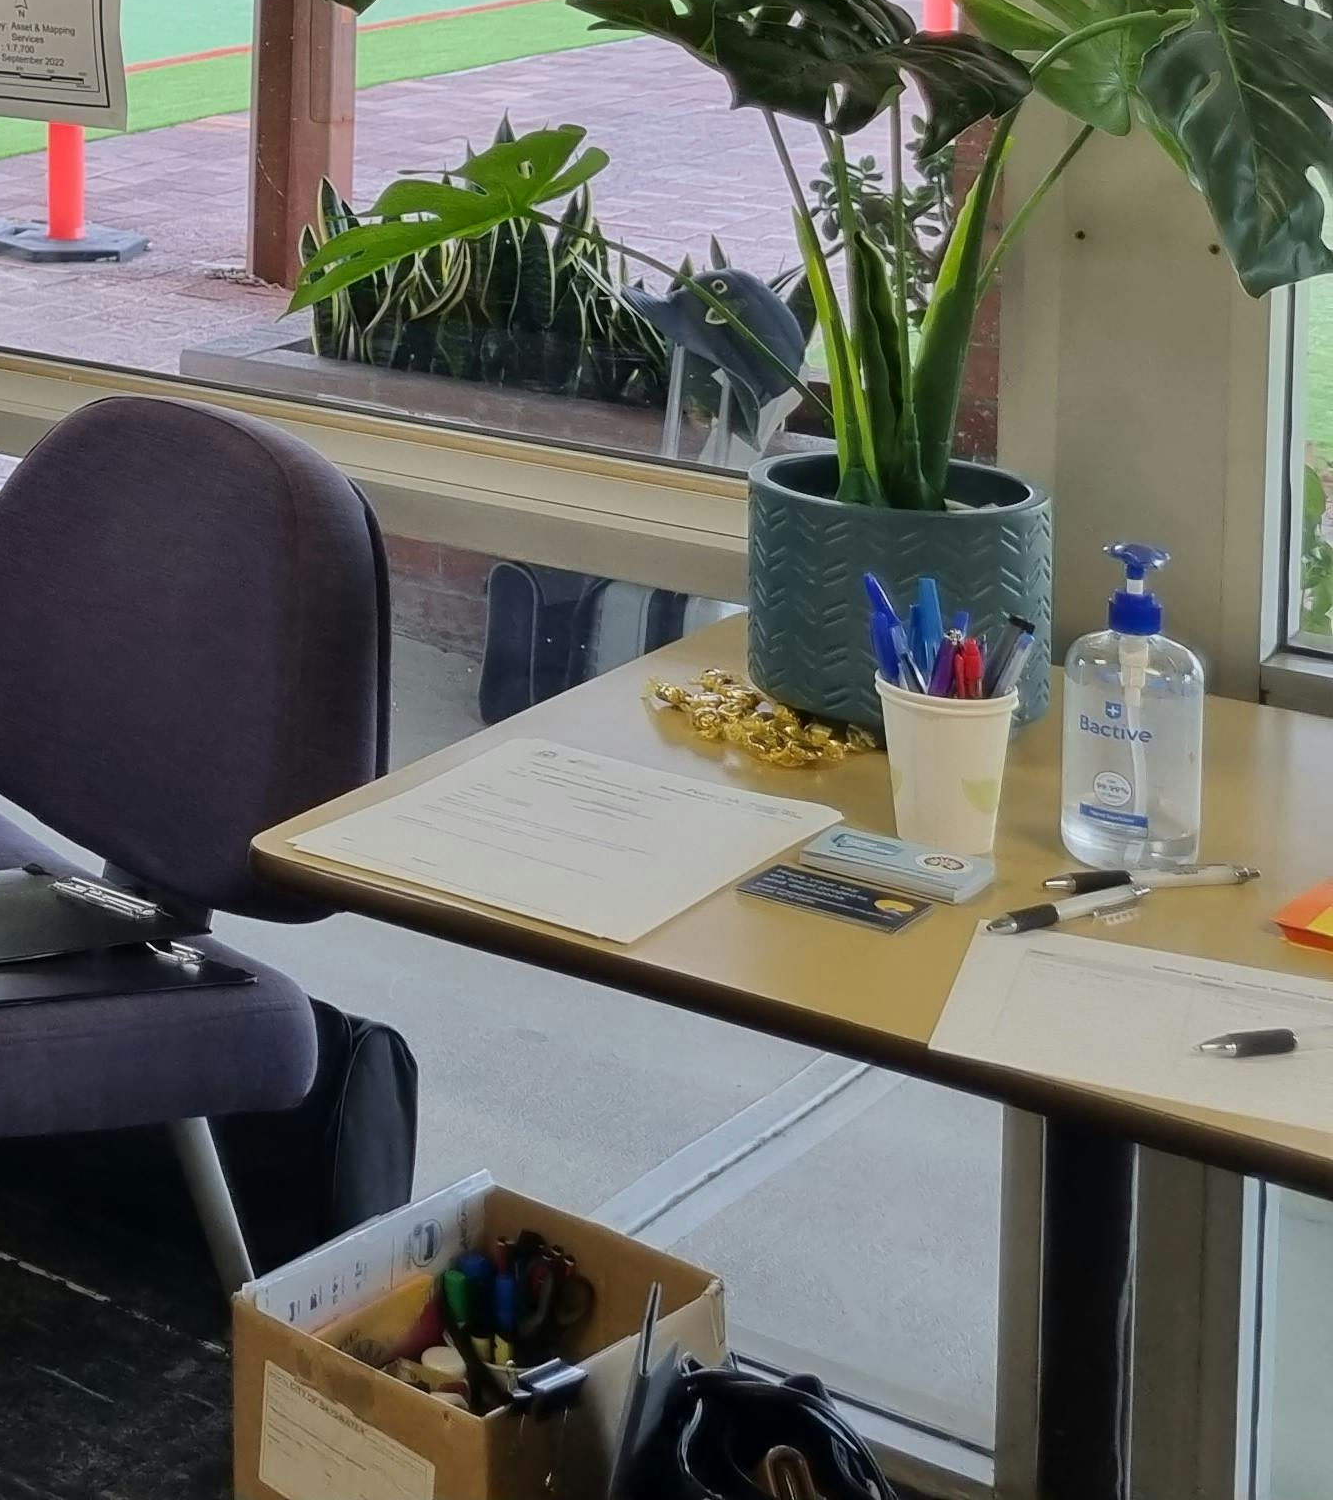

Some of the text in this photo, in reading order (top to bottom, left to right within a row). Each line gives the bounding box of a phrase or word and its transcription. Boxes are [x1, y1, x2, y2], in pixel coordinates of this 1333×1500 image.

[11, 22, 33, 32] Asset
[42, 24, 75, 36] Mapping
[11, 33, 44, 44] Services
[1, 53, 43, 65] September
[45, 56, 65, 67] 2022
[1079, 714, 1152, 743] Bactive
